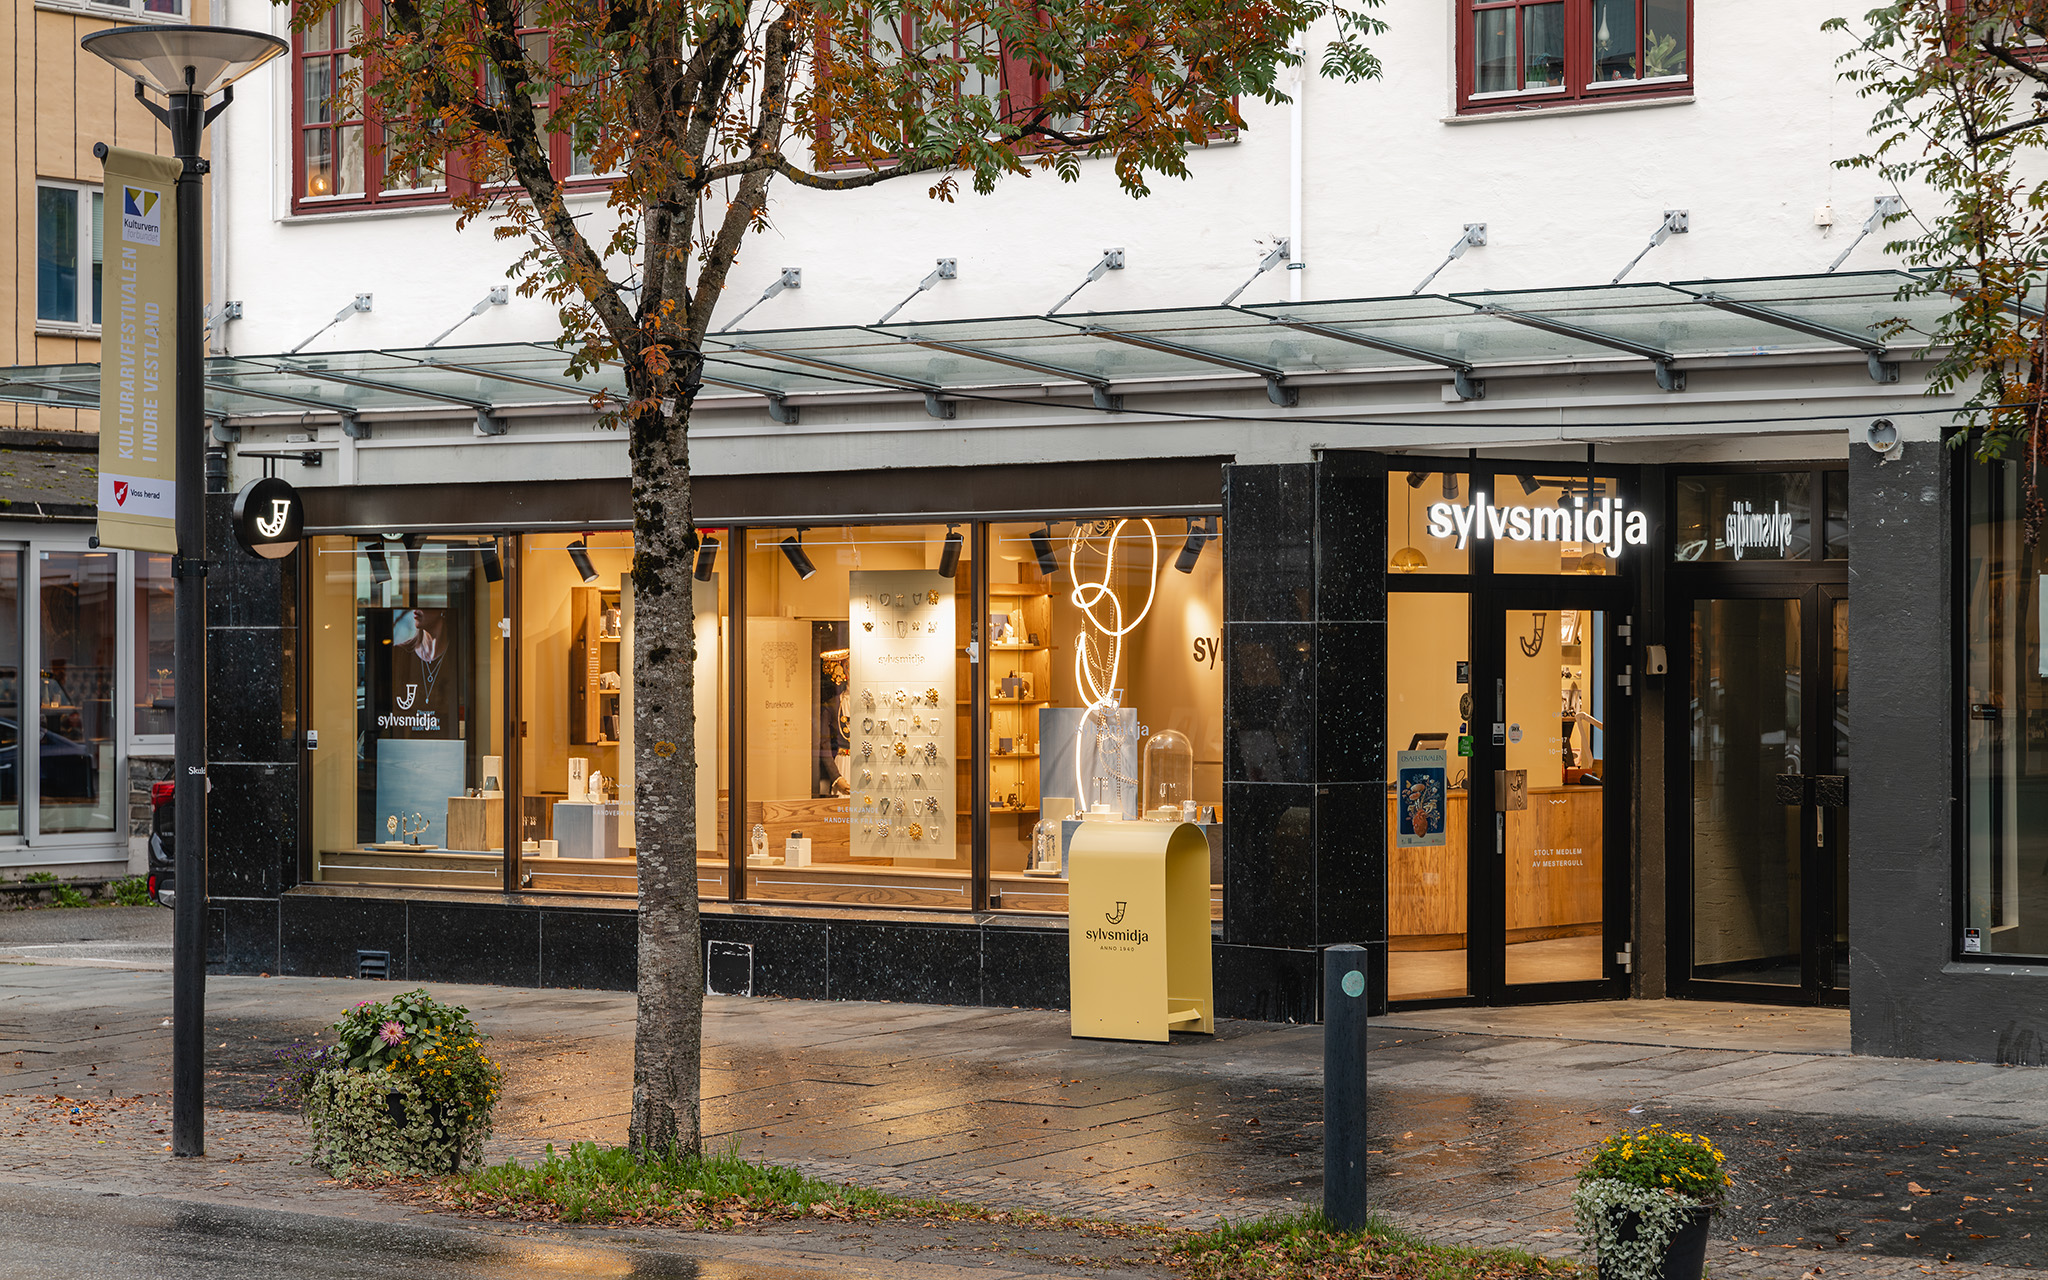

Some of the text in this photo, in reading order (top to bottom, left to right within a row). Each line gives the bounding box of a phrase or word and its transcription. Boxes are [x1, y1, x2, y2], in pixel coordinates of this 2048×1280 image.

[124, 218, 159, 233] Kulturvern
[127, 229, 159, 243] forbundet
[118, 246, 137, 460] KULTURARVFESTIVALEN
[143, 302, 160, 393] VESTLAND
[142, 397, 159, 452] INDRE
[130, 488, 161, 500] Voss herad
[1427, 491, 1648, 560] sylvsmidja
[377, 712, 438, 732] sylvsmidja
[1533, 847, 1583, 857] STOLT MEDLEM
[1542, 859, 1584, 868] MESTERGULL
[1085, 927, 1149, 946] sylvsmidja
